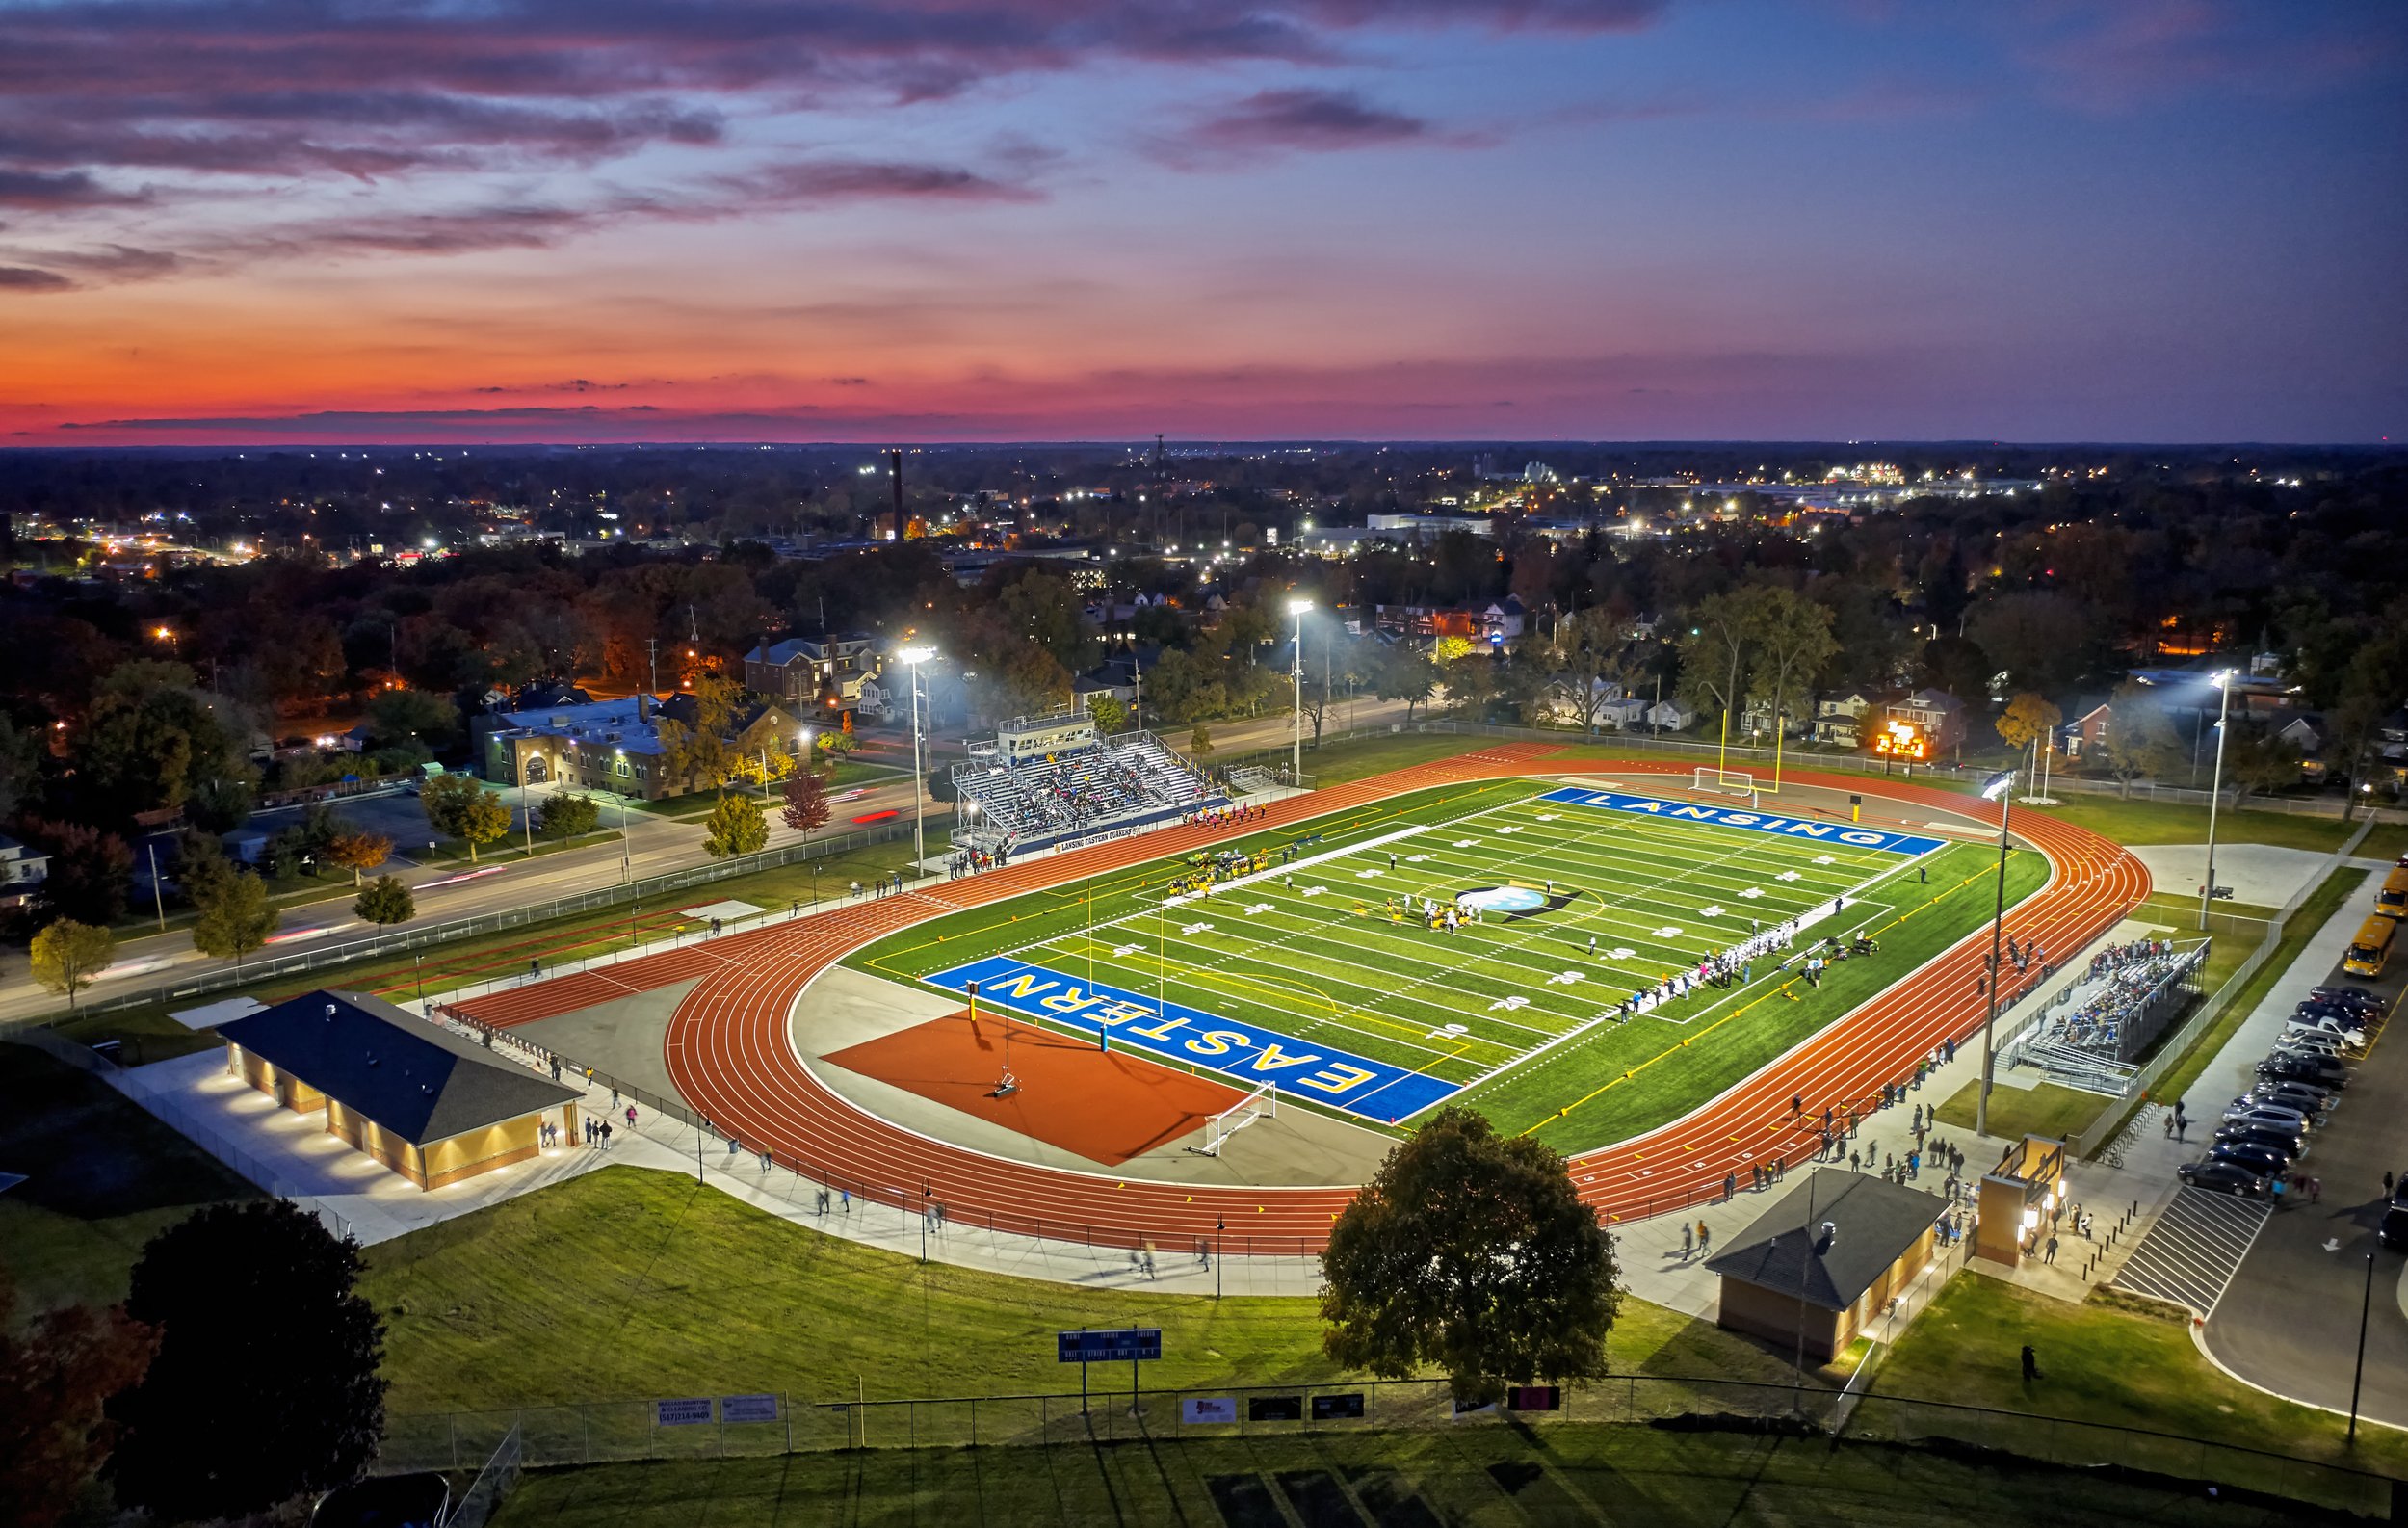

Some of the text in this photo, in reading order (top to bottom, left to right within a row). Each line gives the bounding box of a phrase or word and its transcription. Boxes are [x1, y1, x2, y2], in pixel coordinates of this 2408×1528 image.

[1584, 794, 1886, 845] LANSING
[1061, 829, 1132, 851] LANSING EASTERN QUAKERS
[1552, 970, 1586, 985] 30
[1494, 995, 1531, 1011] 20
[988, 973, 1378, 1094] EASTERN
[1433, 1023, 1469, 1040] 10
[659, 1411, 709, 1423] (517)214-9409
